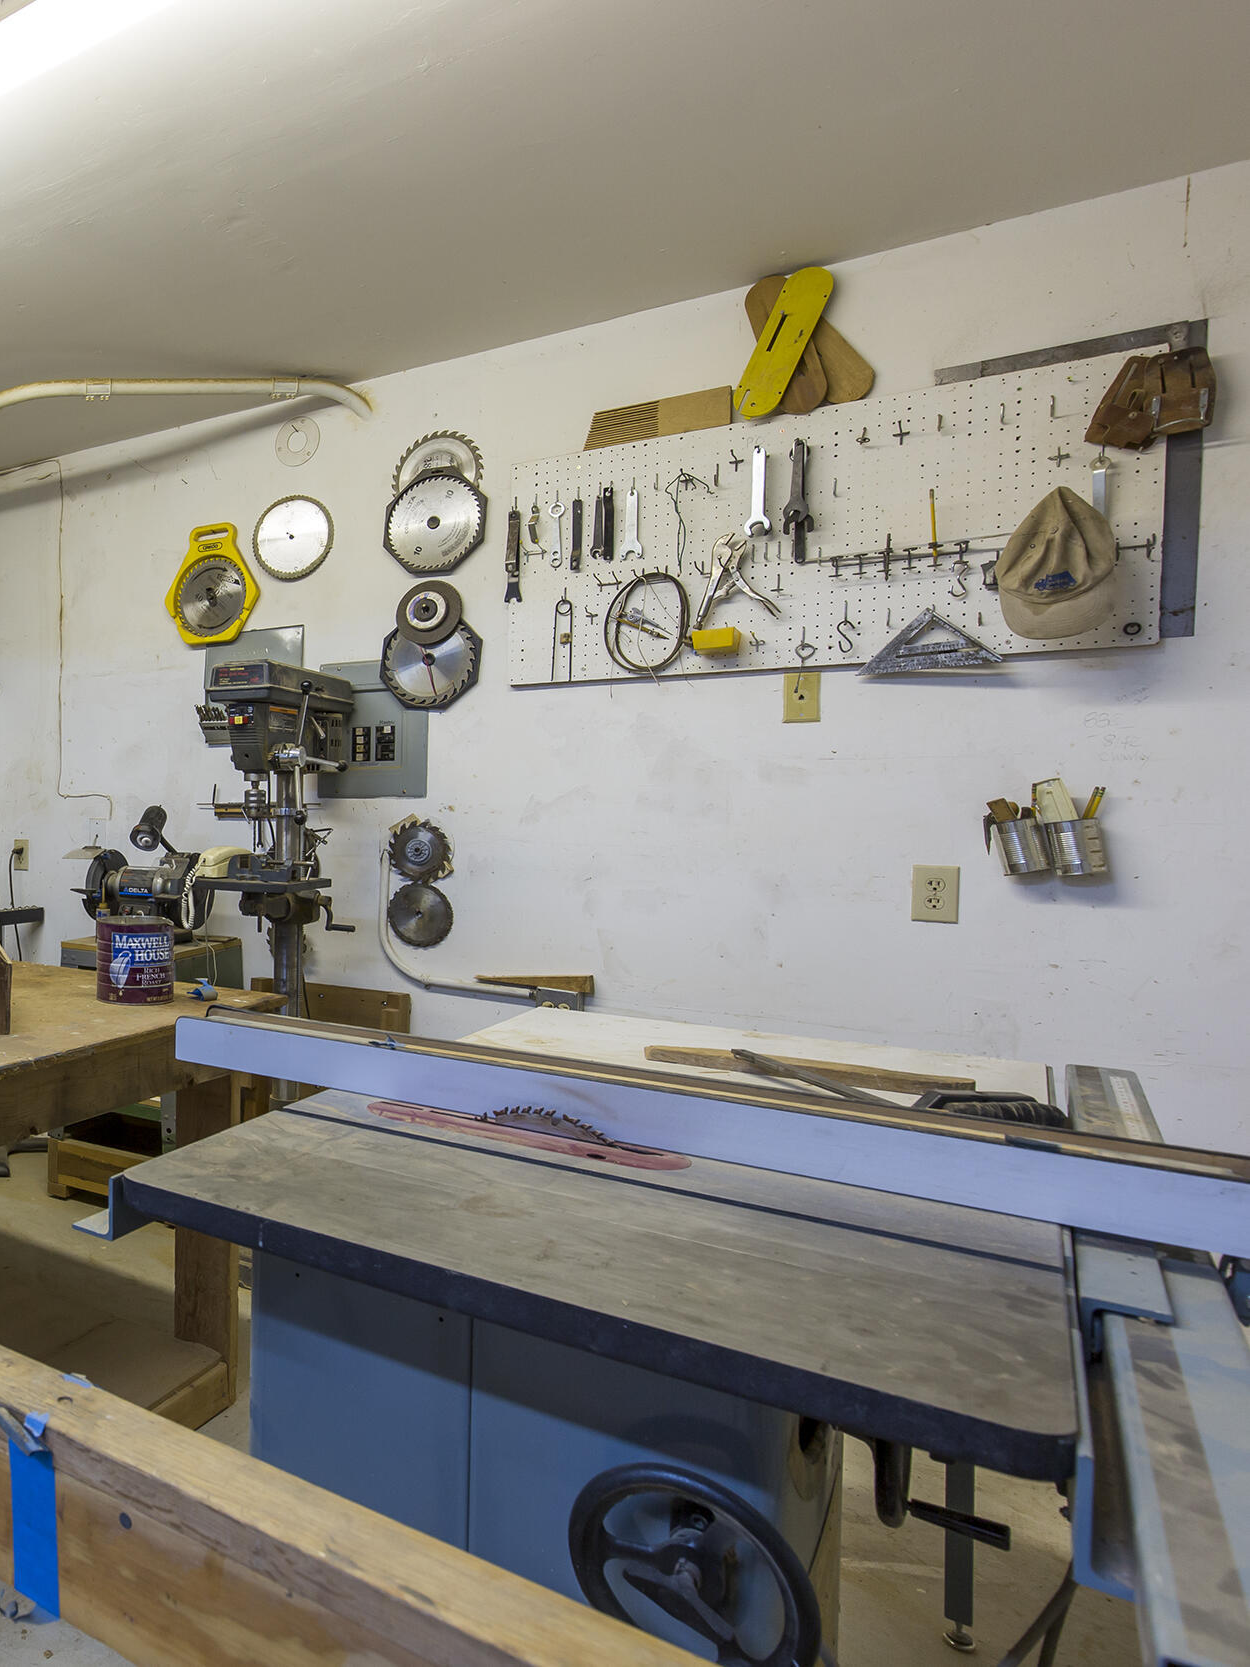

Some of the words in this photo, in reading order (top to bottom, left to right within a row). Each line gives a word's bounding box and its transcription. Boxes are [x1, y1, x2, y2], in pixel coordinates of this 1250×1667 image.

[413, 546, 423, 556] 10
[114, 934, 170, 949] MAXWELL
[134, 948, 170, 962] HOUSE
[136, 972, 166, 981] FRENCH
